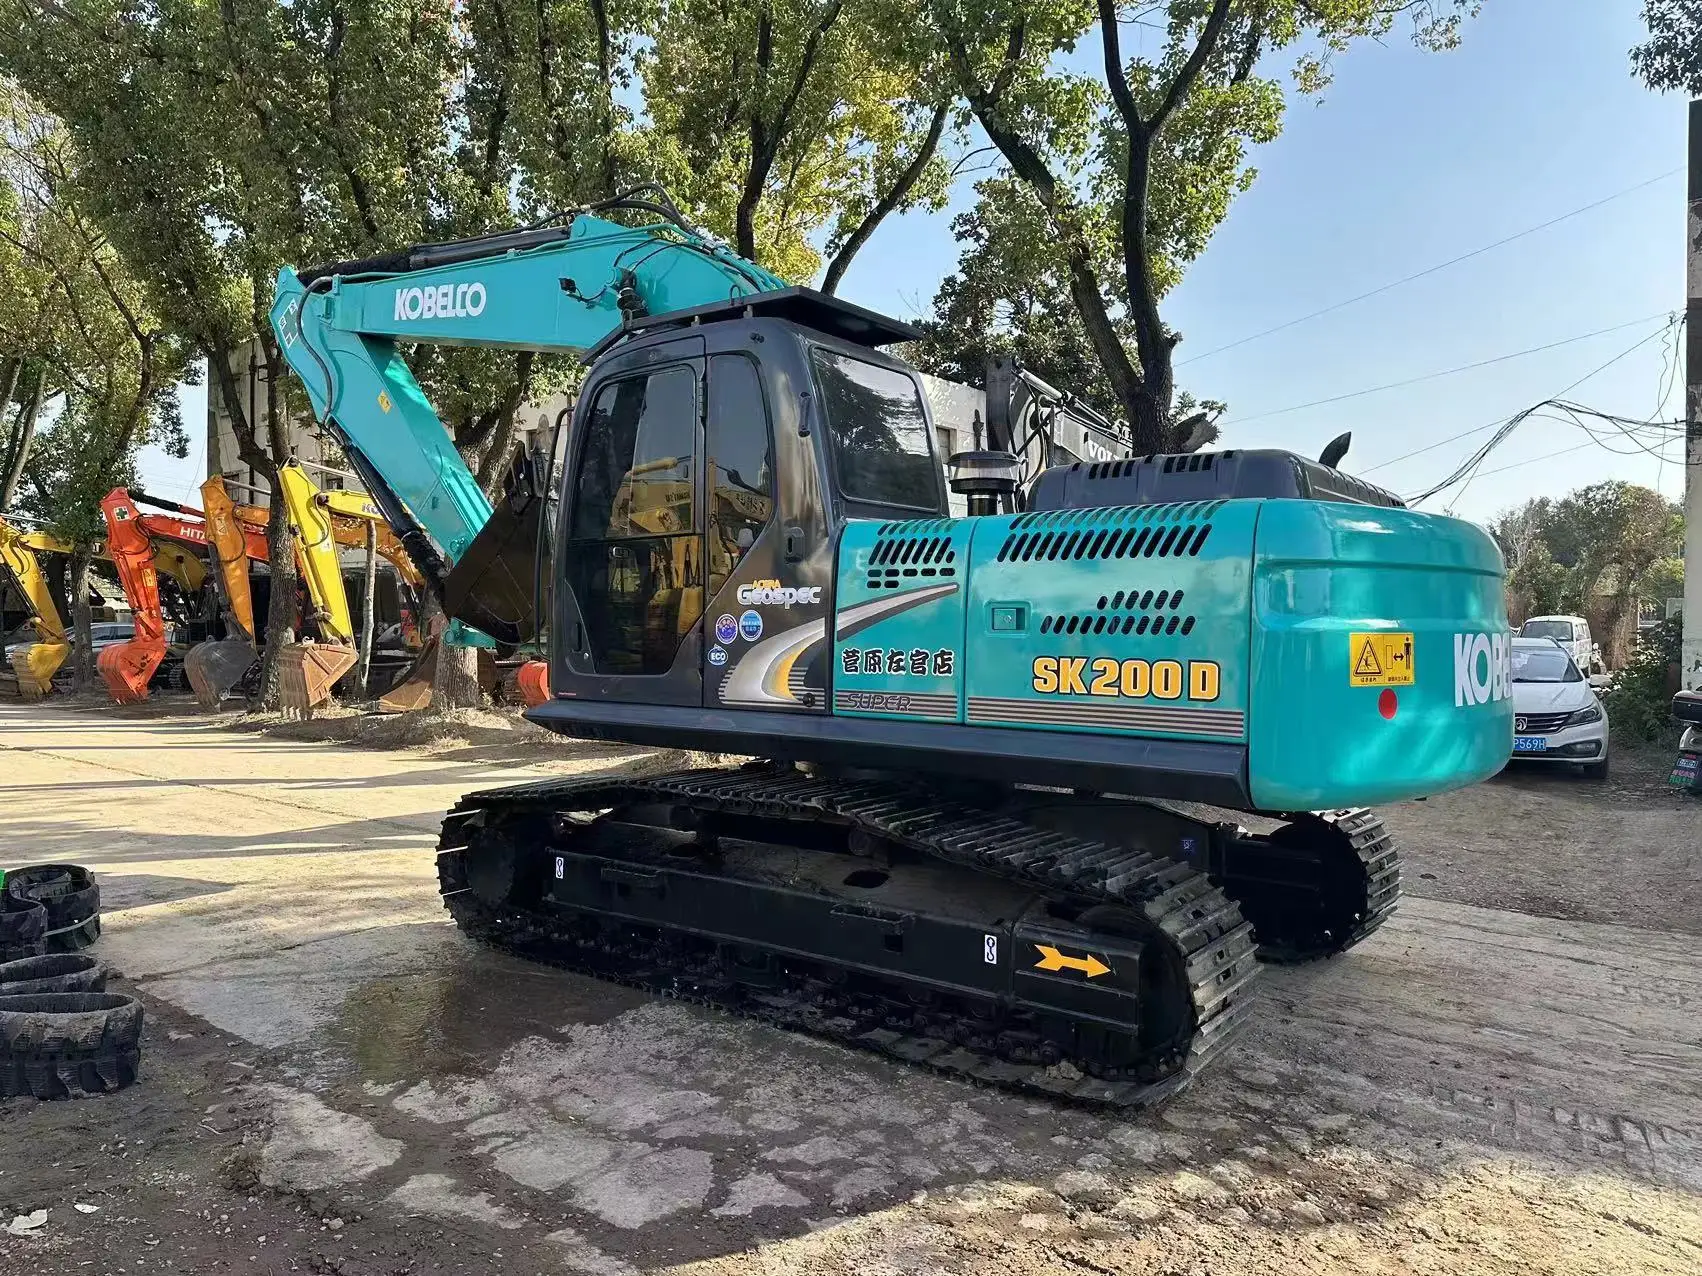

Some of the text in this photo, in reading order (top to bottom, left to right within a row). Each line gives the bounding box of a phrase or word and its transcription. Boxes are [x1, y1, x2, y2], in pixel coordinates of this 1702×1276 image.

[394, 282, 487, 321] KOBELCO
[711, 652, 726, 661] ECO
[847, 693, 912, 712] SUPER
